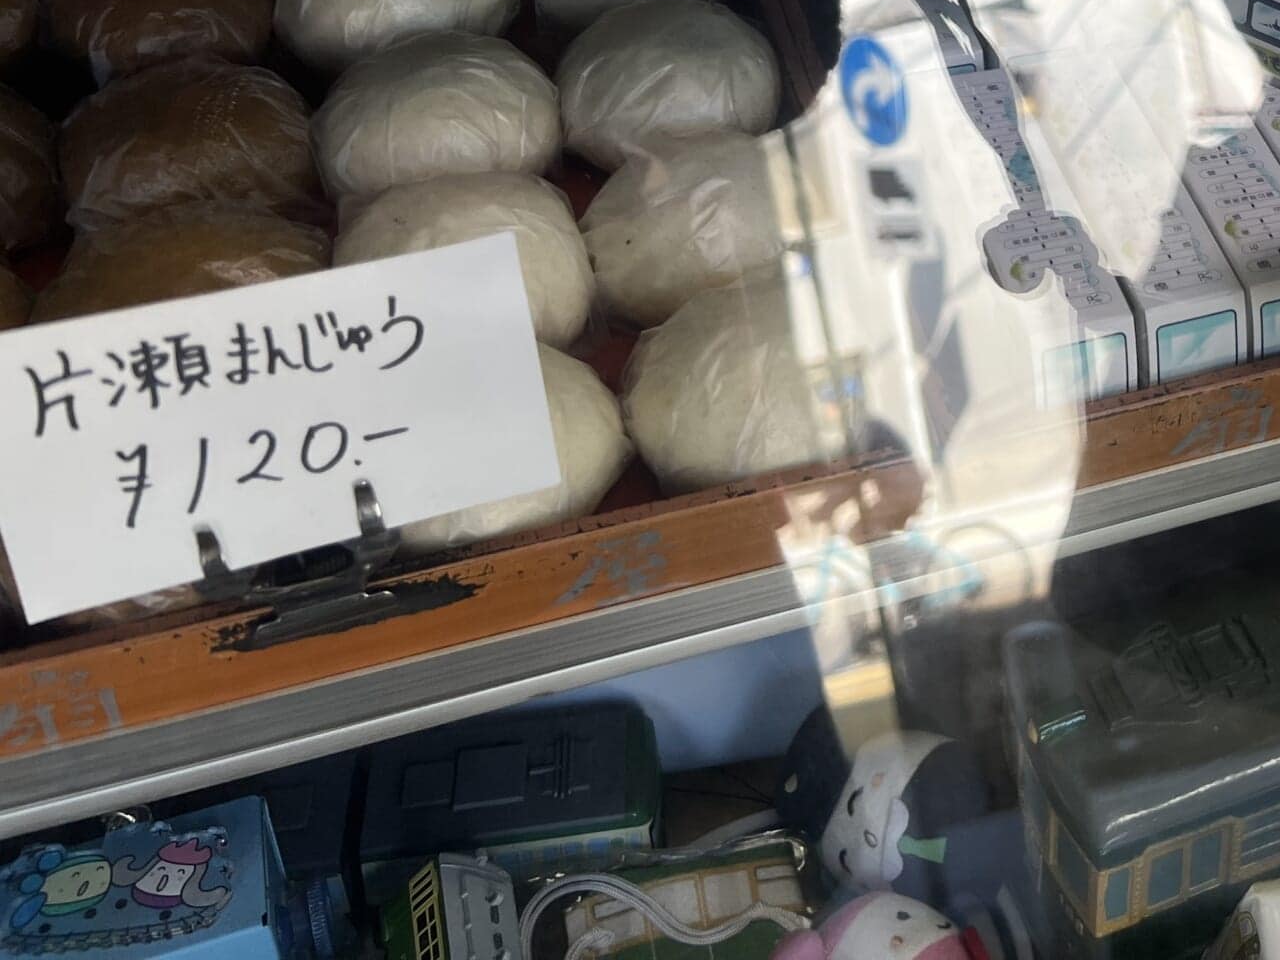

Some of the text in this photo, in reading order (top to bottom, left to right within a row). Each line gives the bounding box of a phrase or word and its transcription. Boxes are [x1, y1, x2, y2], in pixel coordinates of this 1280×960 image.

[23, 295, 425, 437] 片瀬まんじゅう
